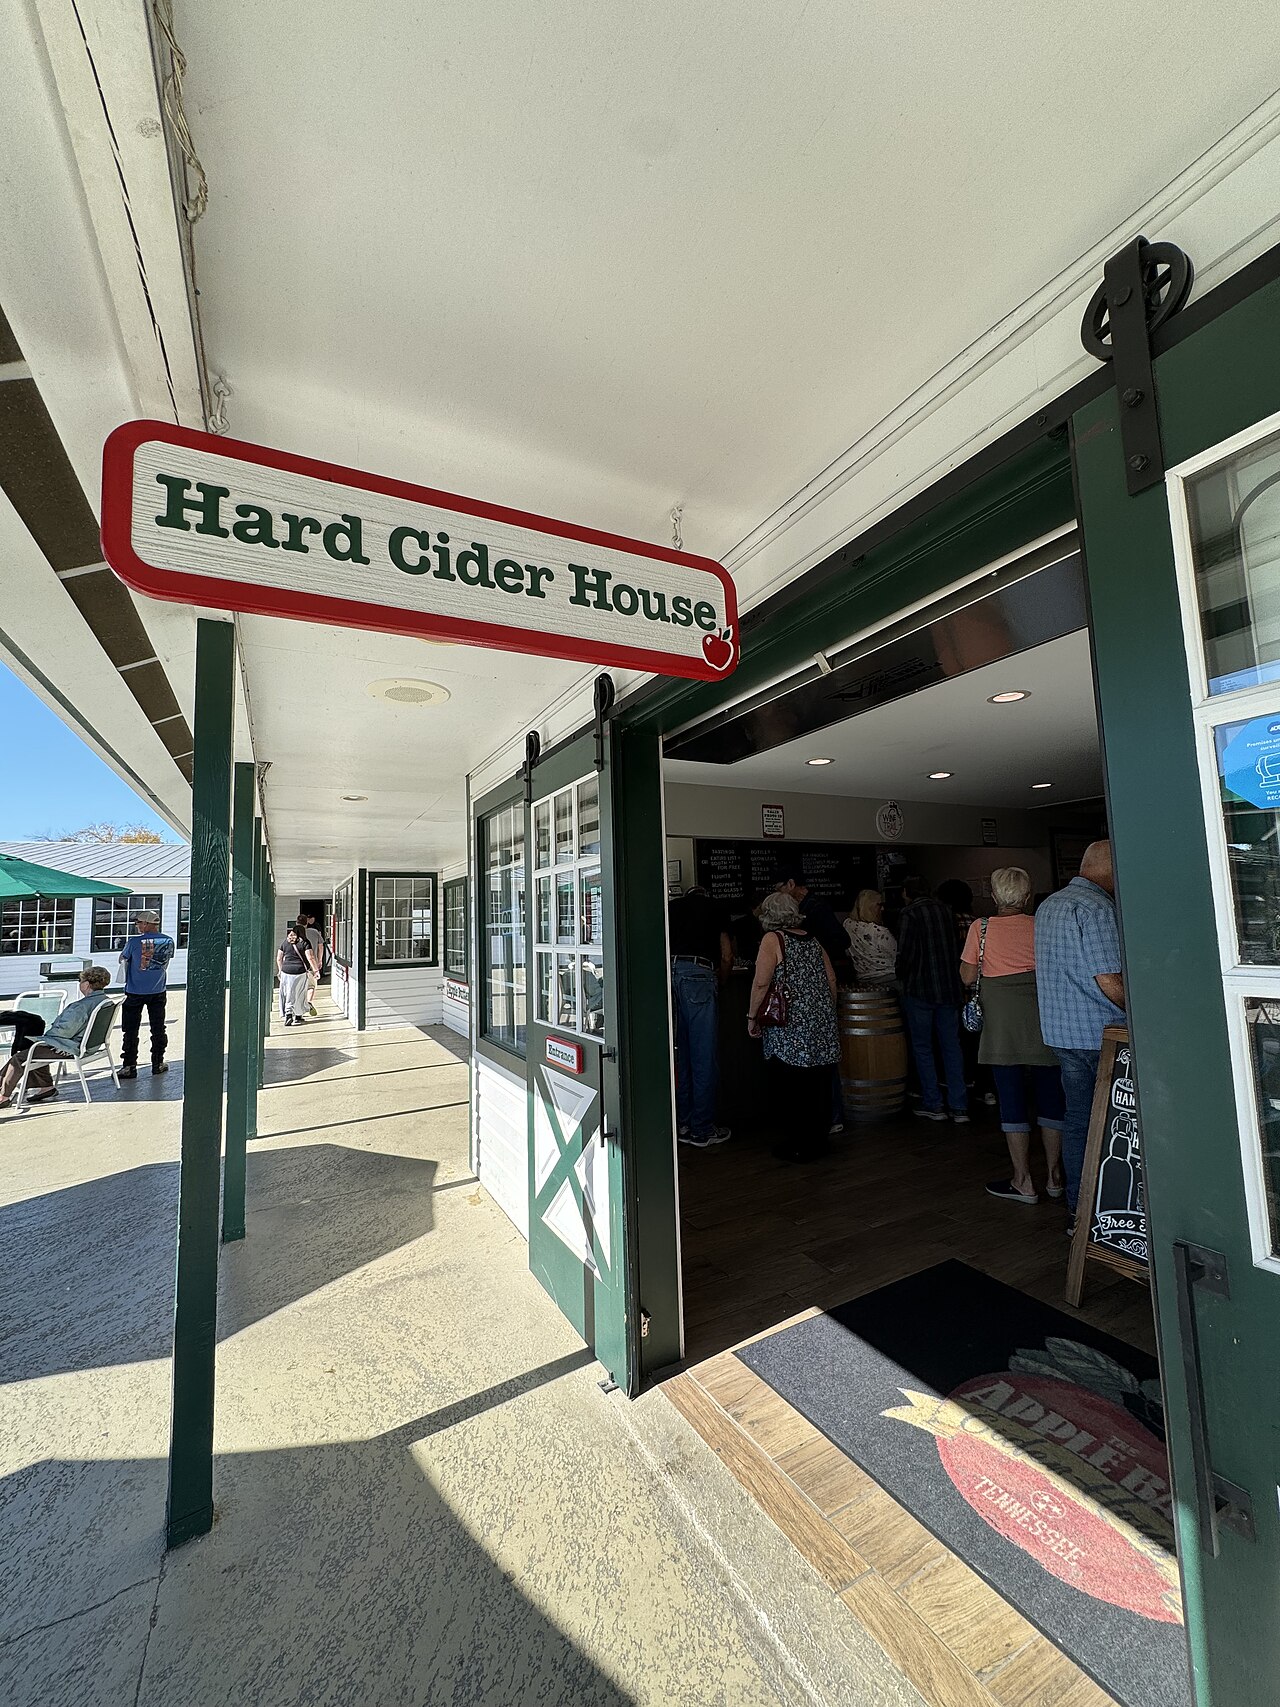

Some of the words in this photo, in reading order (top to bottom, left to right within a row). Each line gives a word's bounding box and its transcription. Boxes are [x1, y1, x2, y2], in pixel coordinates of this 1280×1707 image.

[155, 473, 370, 567] Hard
[388, 526, 555, 599] Cider
[567, 563, 717, 631] House
[1246, 739, 1272, 748] Premises
[548, 1044, 575, 1064] Entrance
[1100, 1215, 1136, 1231] Free
[960, 1380, 1127, 1475] APPLE
[973, 1475, 1086, 1567] TENNESSEE
